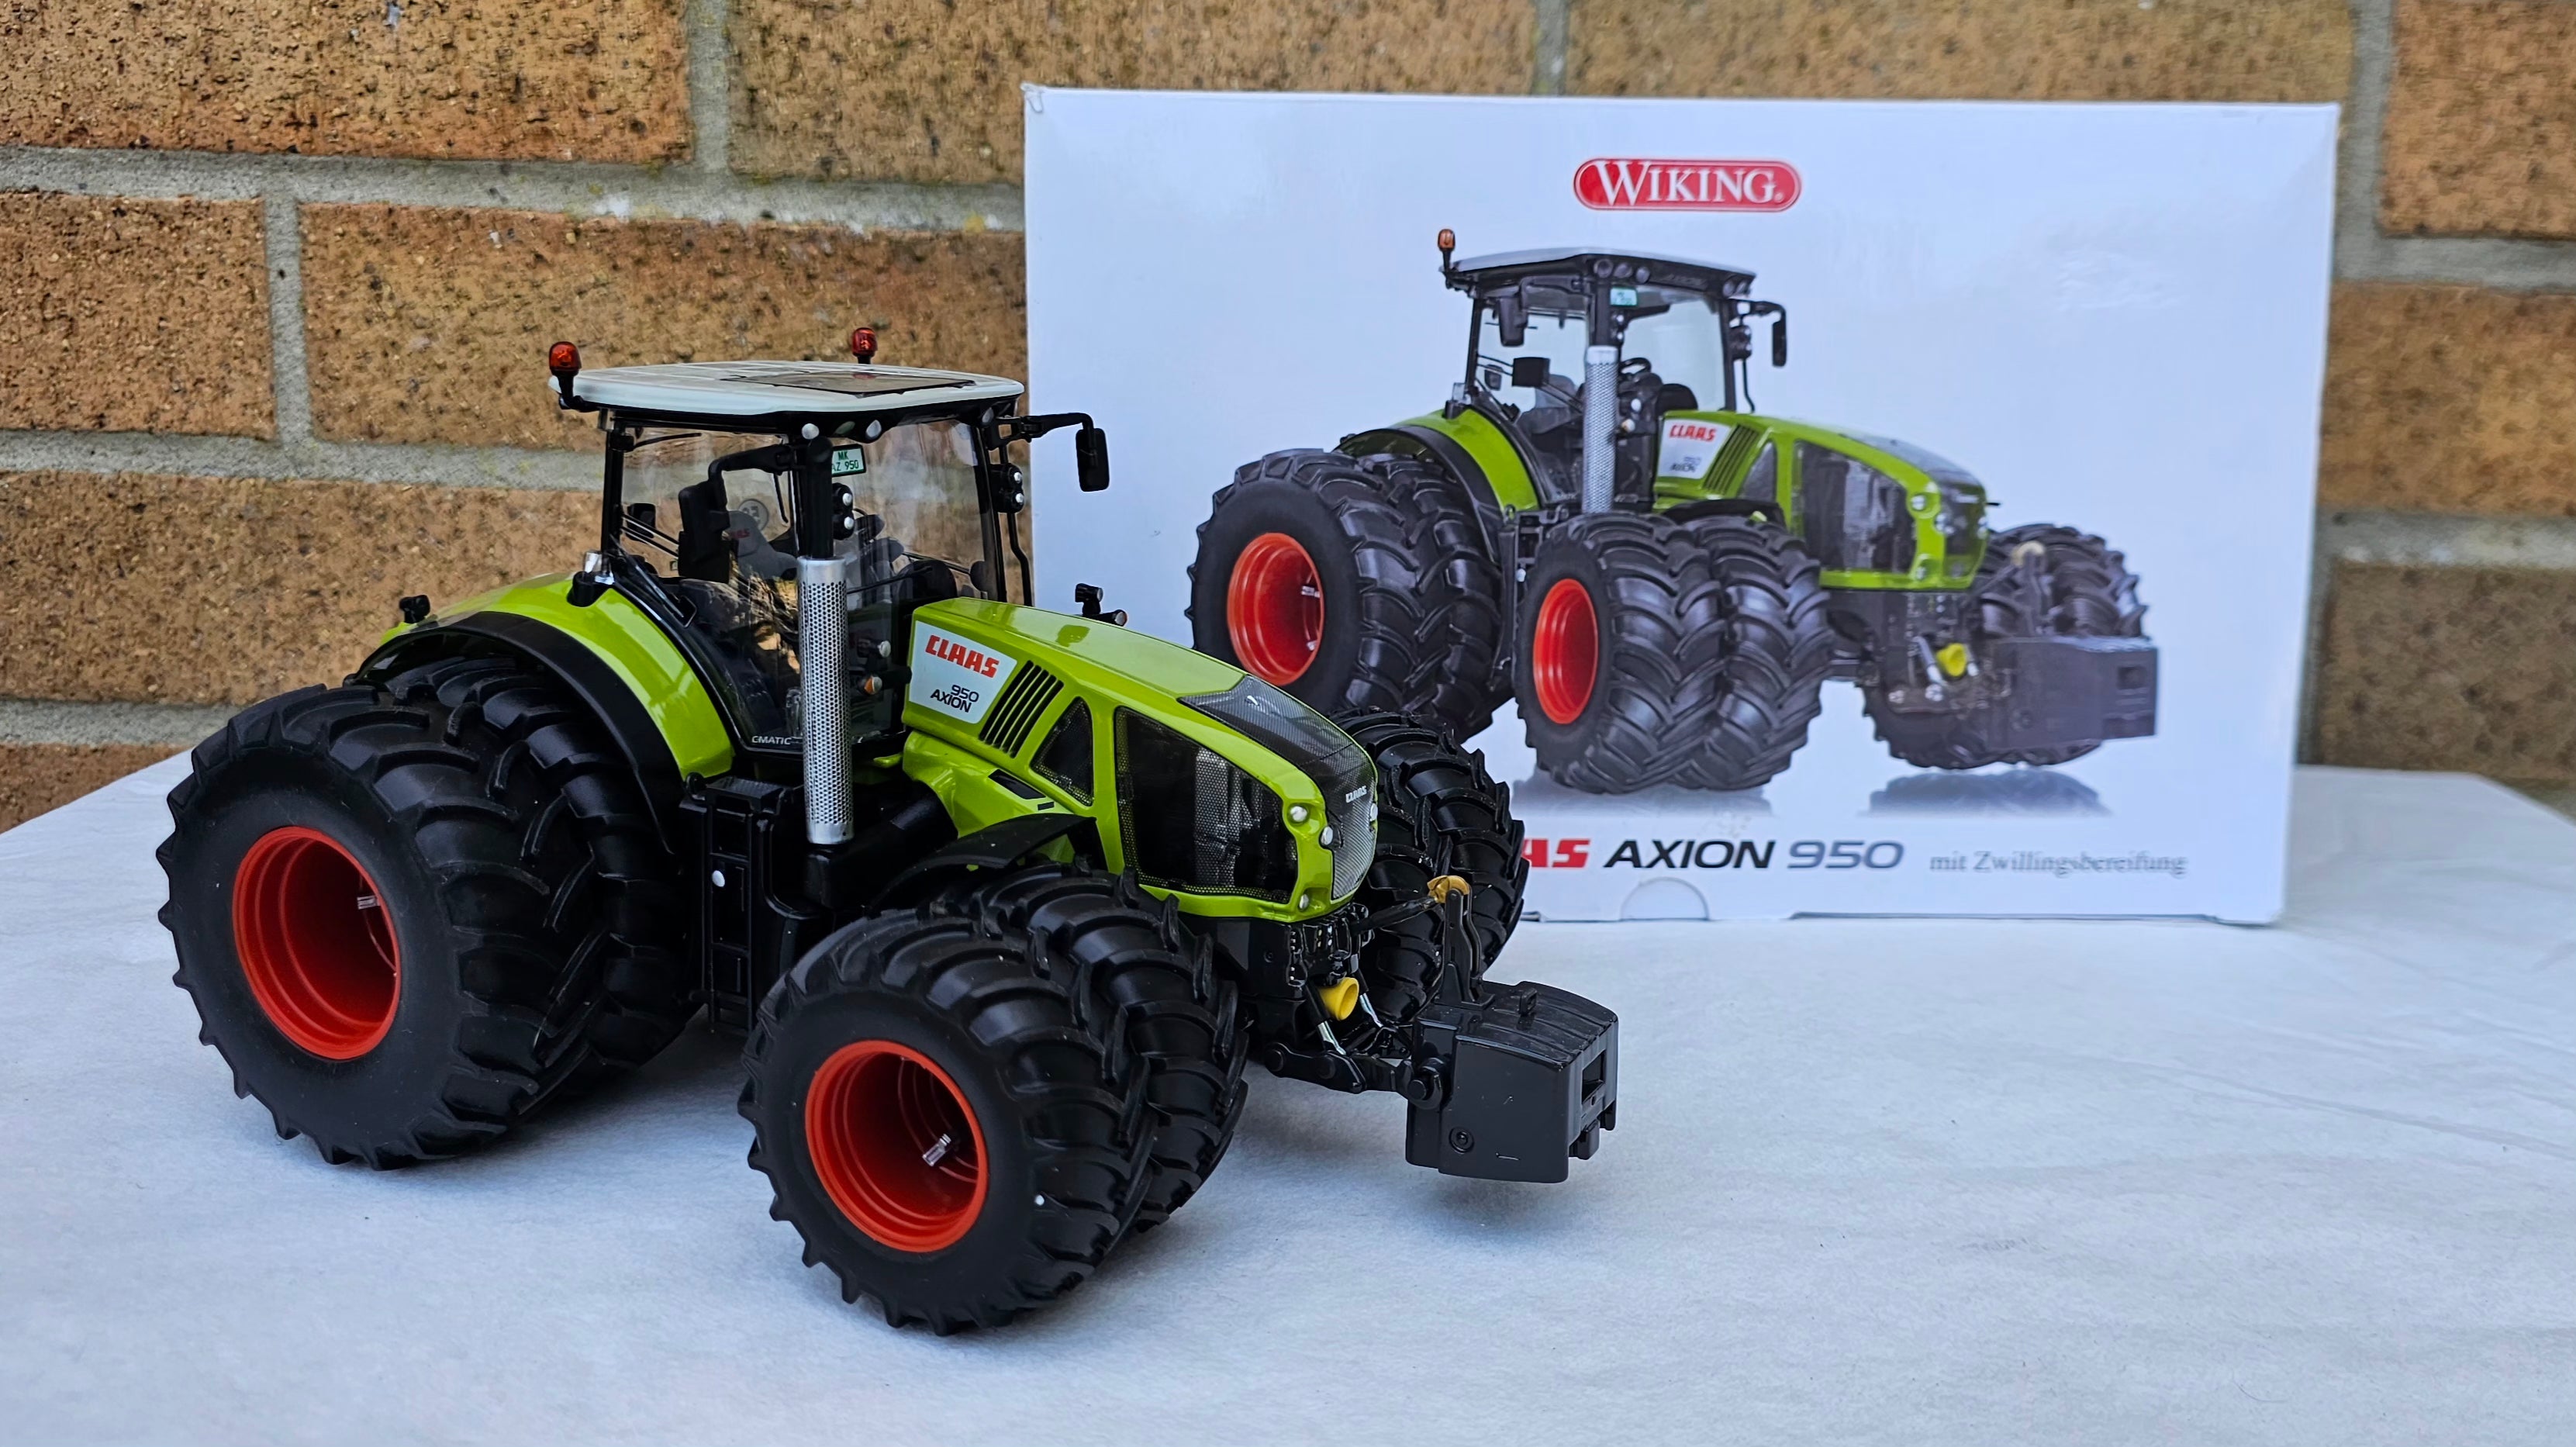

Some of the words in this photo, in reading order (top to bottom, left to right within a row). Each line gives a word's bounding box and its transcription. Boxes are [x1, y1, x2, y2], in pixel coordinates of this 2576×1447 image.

[1669, 424, 1717, 443] CLAAS
[838, 451, 849, 460] MK
[844, 460, 859, 470] 950
[925, 634, 1000, 679] CLAAS
[931, 689, 972, 713] AXION
[951, 684, 979, 703] 950
[751, 735, 792, 745] CMATIC
[1602, 839, 1776, 869] AXION
[1787, 840, 1905, 869] 950
[1929, 851, 1968, 870] mit
[1973, 851, 2189, 879] Zwillingsbereifung
